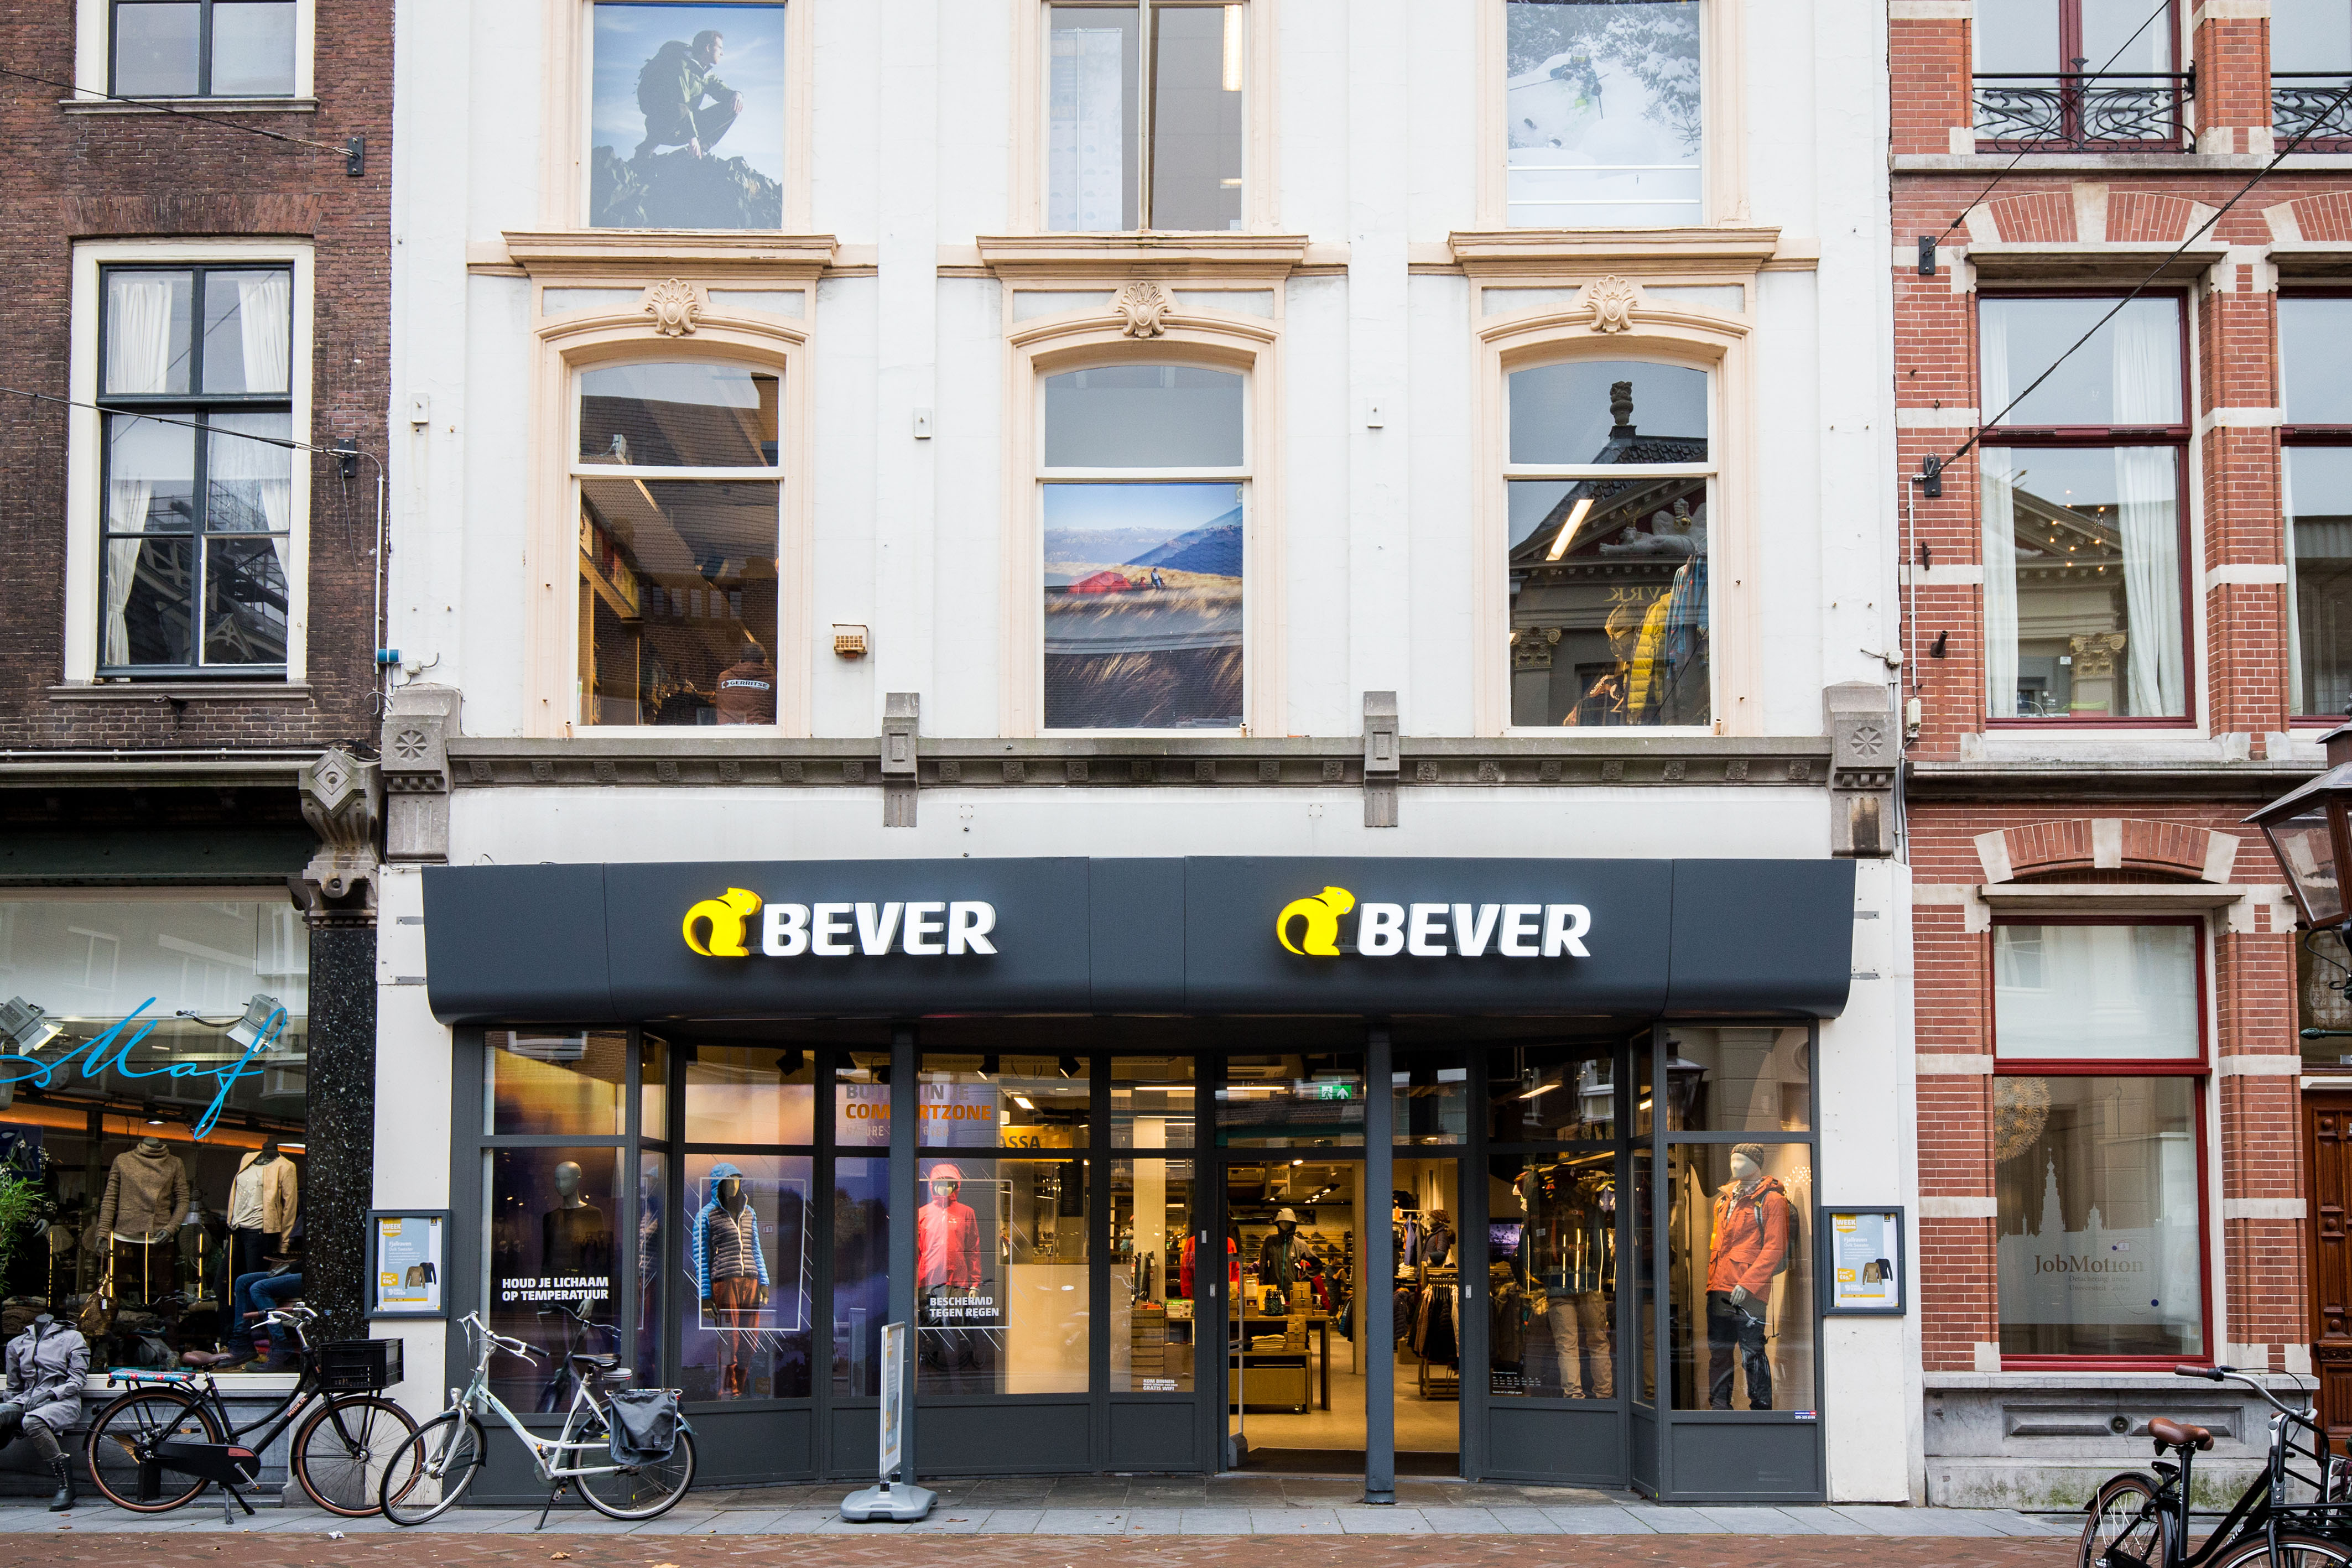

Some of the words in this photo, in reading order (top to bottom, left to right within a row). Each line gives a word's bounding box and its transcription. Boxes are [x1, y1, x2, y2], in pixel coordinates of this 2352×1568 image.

[763, 901, 997, 956] BEVER
[1356, 902, 1590, 957] BEVER
[924, 1085, 944, 1100] IN
[846, 1103, 992, 1120] COMRTZONE
[1000, 1135, 1040, 1148] ASSA
[2034, 1254, 2143, 1275] JobMotion
[502, 1278, 536, 1289] HOUD
[538, 1278, 551, 1288] JE
[554, 1277, 608, 1288] LICHAAM
[502, 1291, 518, 1301] OP
[521, 1289, 608, 1300] TEMPERATUUR
[930, 1296, 993, 1306] BESCHERMD
[929, 1308, 963, 1317] TEGEN
[965, 1307, 999, 1317] REGEN
